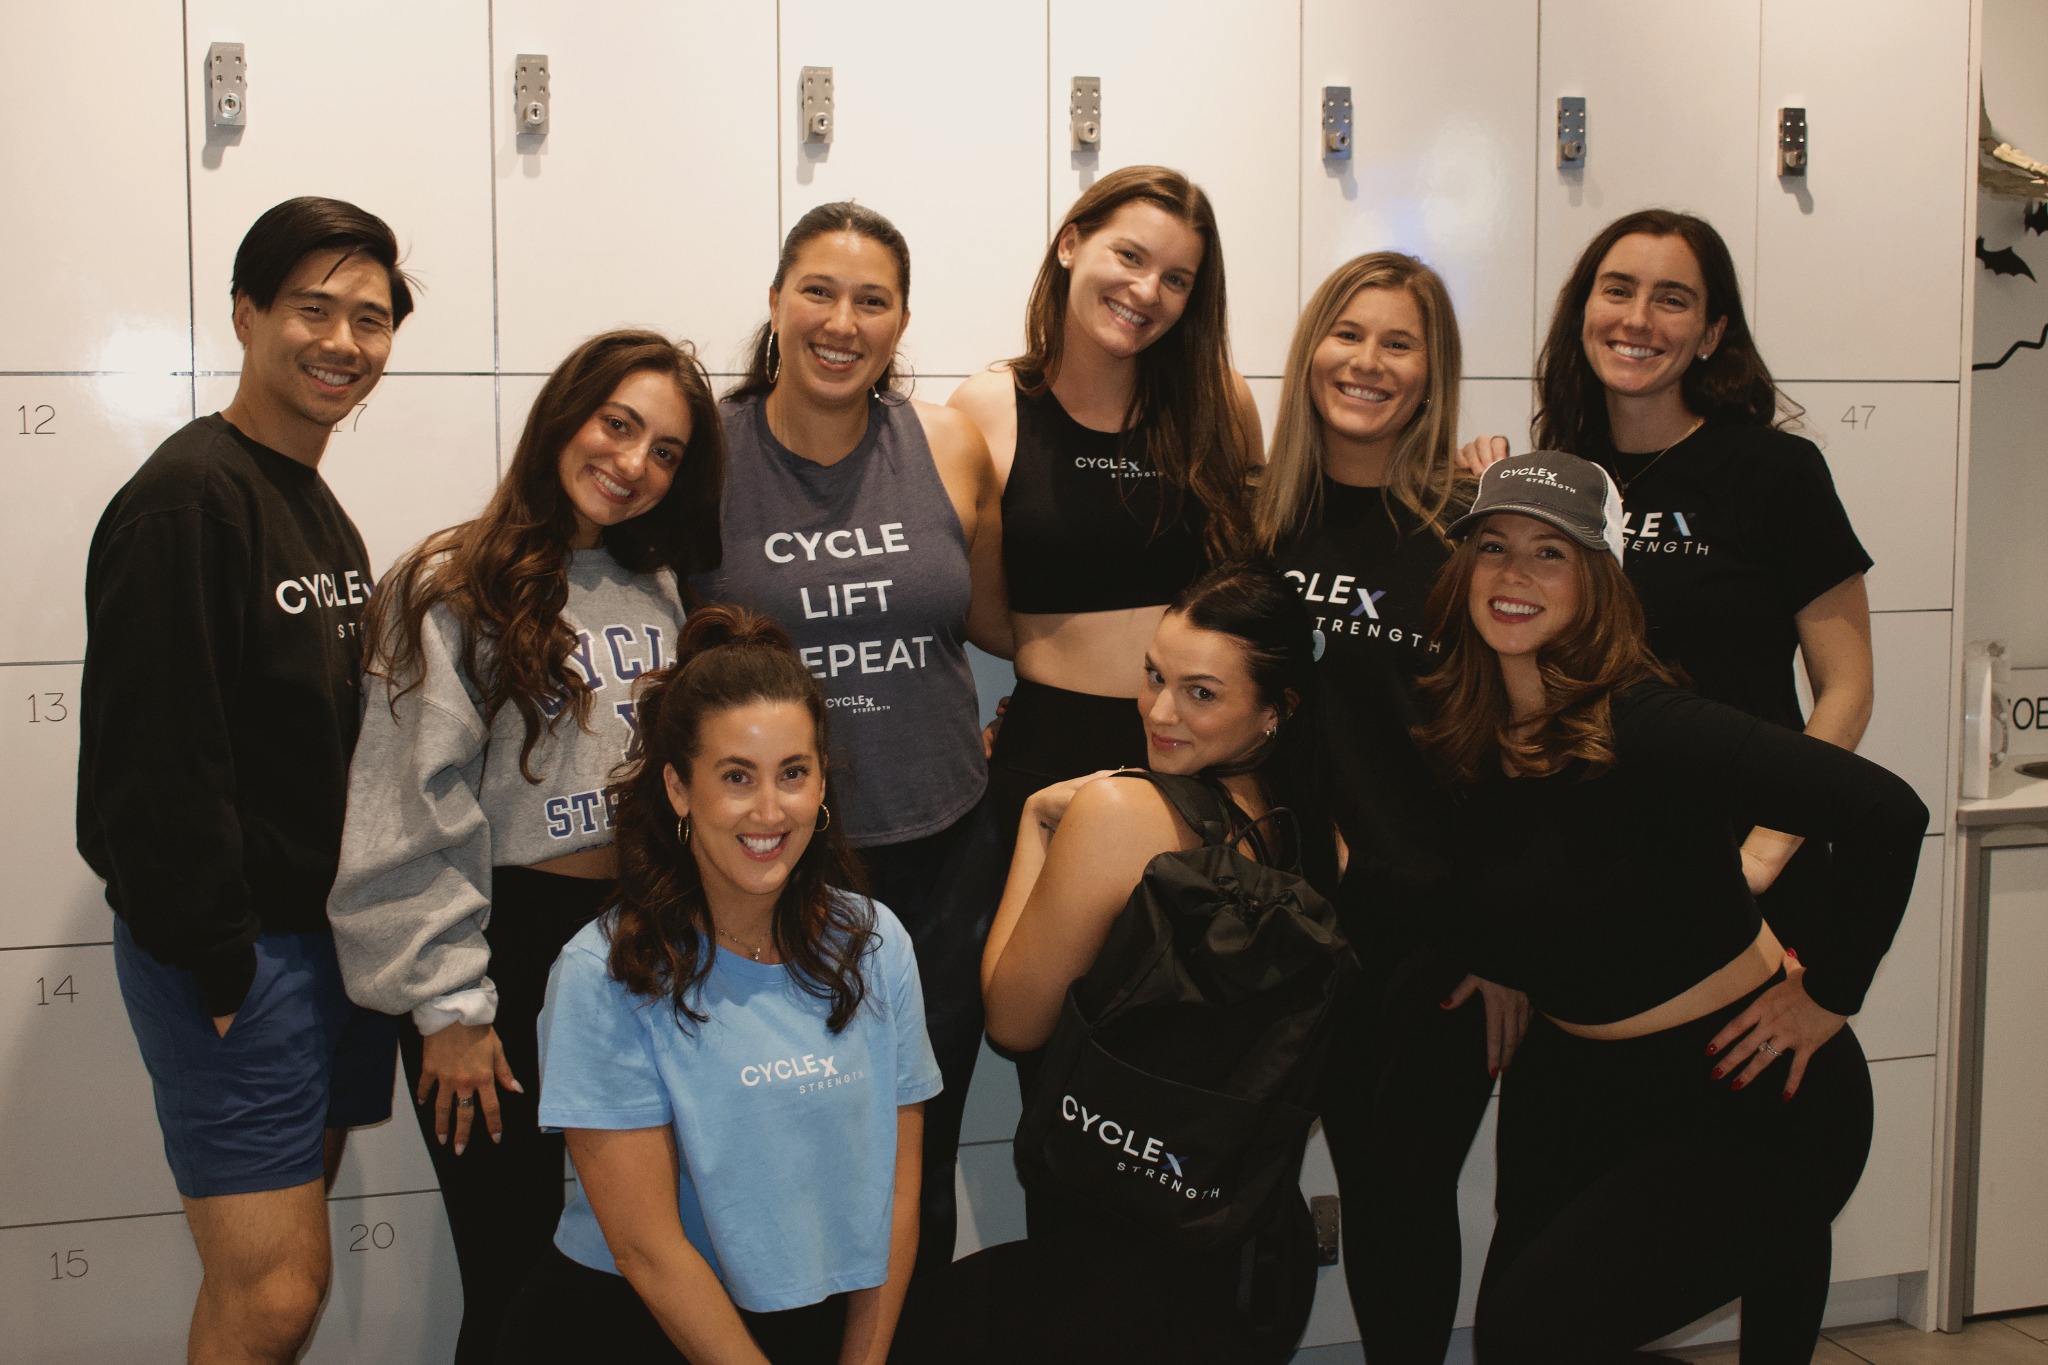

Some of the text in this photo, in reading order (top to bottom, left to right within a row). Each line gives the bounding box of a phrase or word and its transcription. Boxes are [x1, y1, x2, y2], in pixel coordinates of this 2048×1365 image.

[17, 404, 56, 435] 12
[1840, 404, 1877, 430] 47
[1075, 457, 1140, 472] CYCLEX
[1111, 471, 1164, 479] SRENGTH
[1500, 467, 1558, 482] CYCLEX
[1526, 477, 1576, 494] STRENGTH
[1622, 511, 1697, 538] LEX
[764, 522, 910, 564] CYCLE
[1622, 536, 1709, 556] RENGTH
[800, 579, 893, 620] LIFT
[1315, 616, 1442, 654] TRENGTH
[799, 635, 934, 679] EPEAT
[28, 693, 68, 724] 13
[825, 694, 875, 709] CYCLEX
[852, 705, 891, 714] STRENGTH
[36, 975, 80, 1006] 14
[740, 1053, 839, 1087] CYCLEX
[799, 1070, 865, 1094] STRENGTH
[1062, 1094, 1190, 1178] CYCLEX
[1117, 1162, 1220, 1199] STRENGTH
[349, 1221, 395, 1253] 20
[50, 1249, 89, 1281] 15
